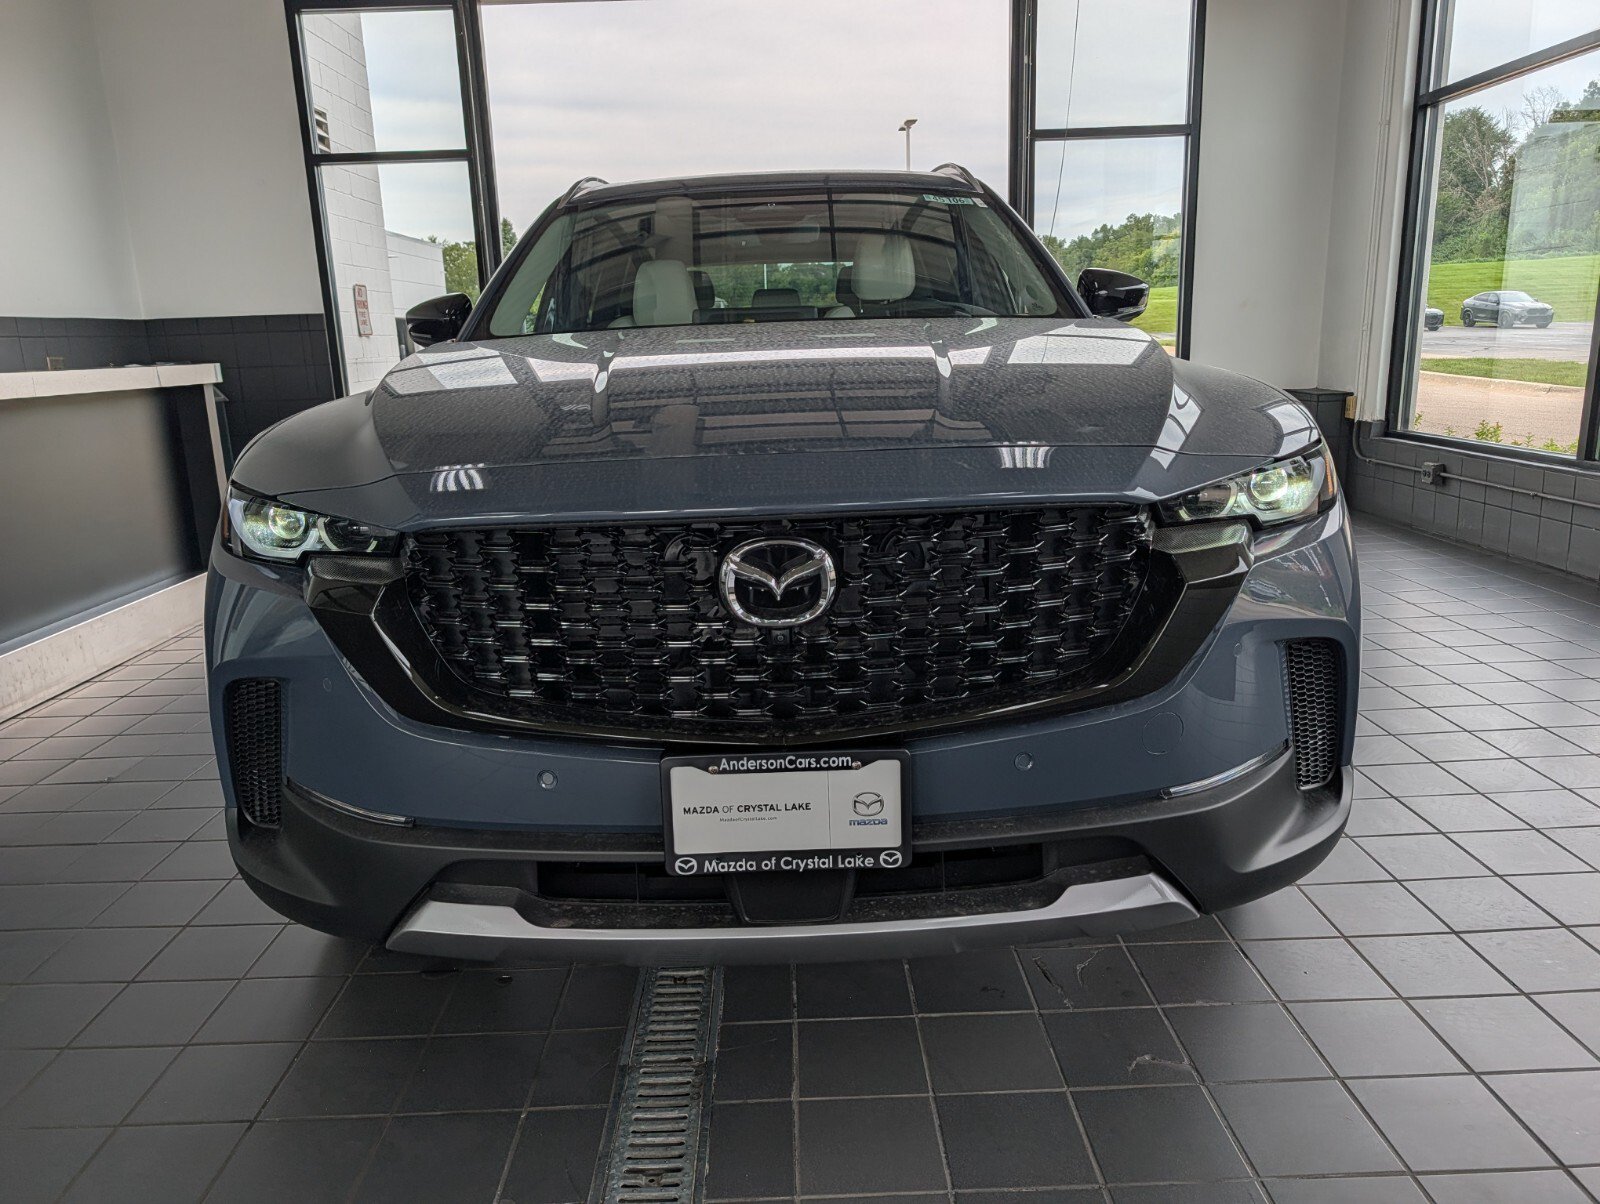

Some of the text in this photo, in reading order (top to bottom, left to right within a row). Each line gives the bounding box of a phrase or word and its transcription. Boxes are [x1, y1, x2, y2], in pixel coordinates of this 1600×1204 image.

[719, 755, 852, 771] AndersonCars.com
[683, 802, 812, 816] MAZDA OF CRYSTAL LAKE
[703, 855, 875, 874] Mazda of Crystal Lake
